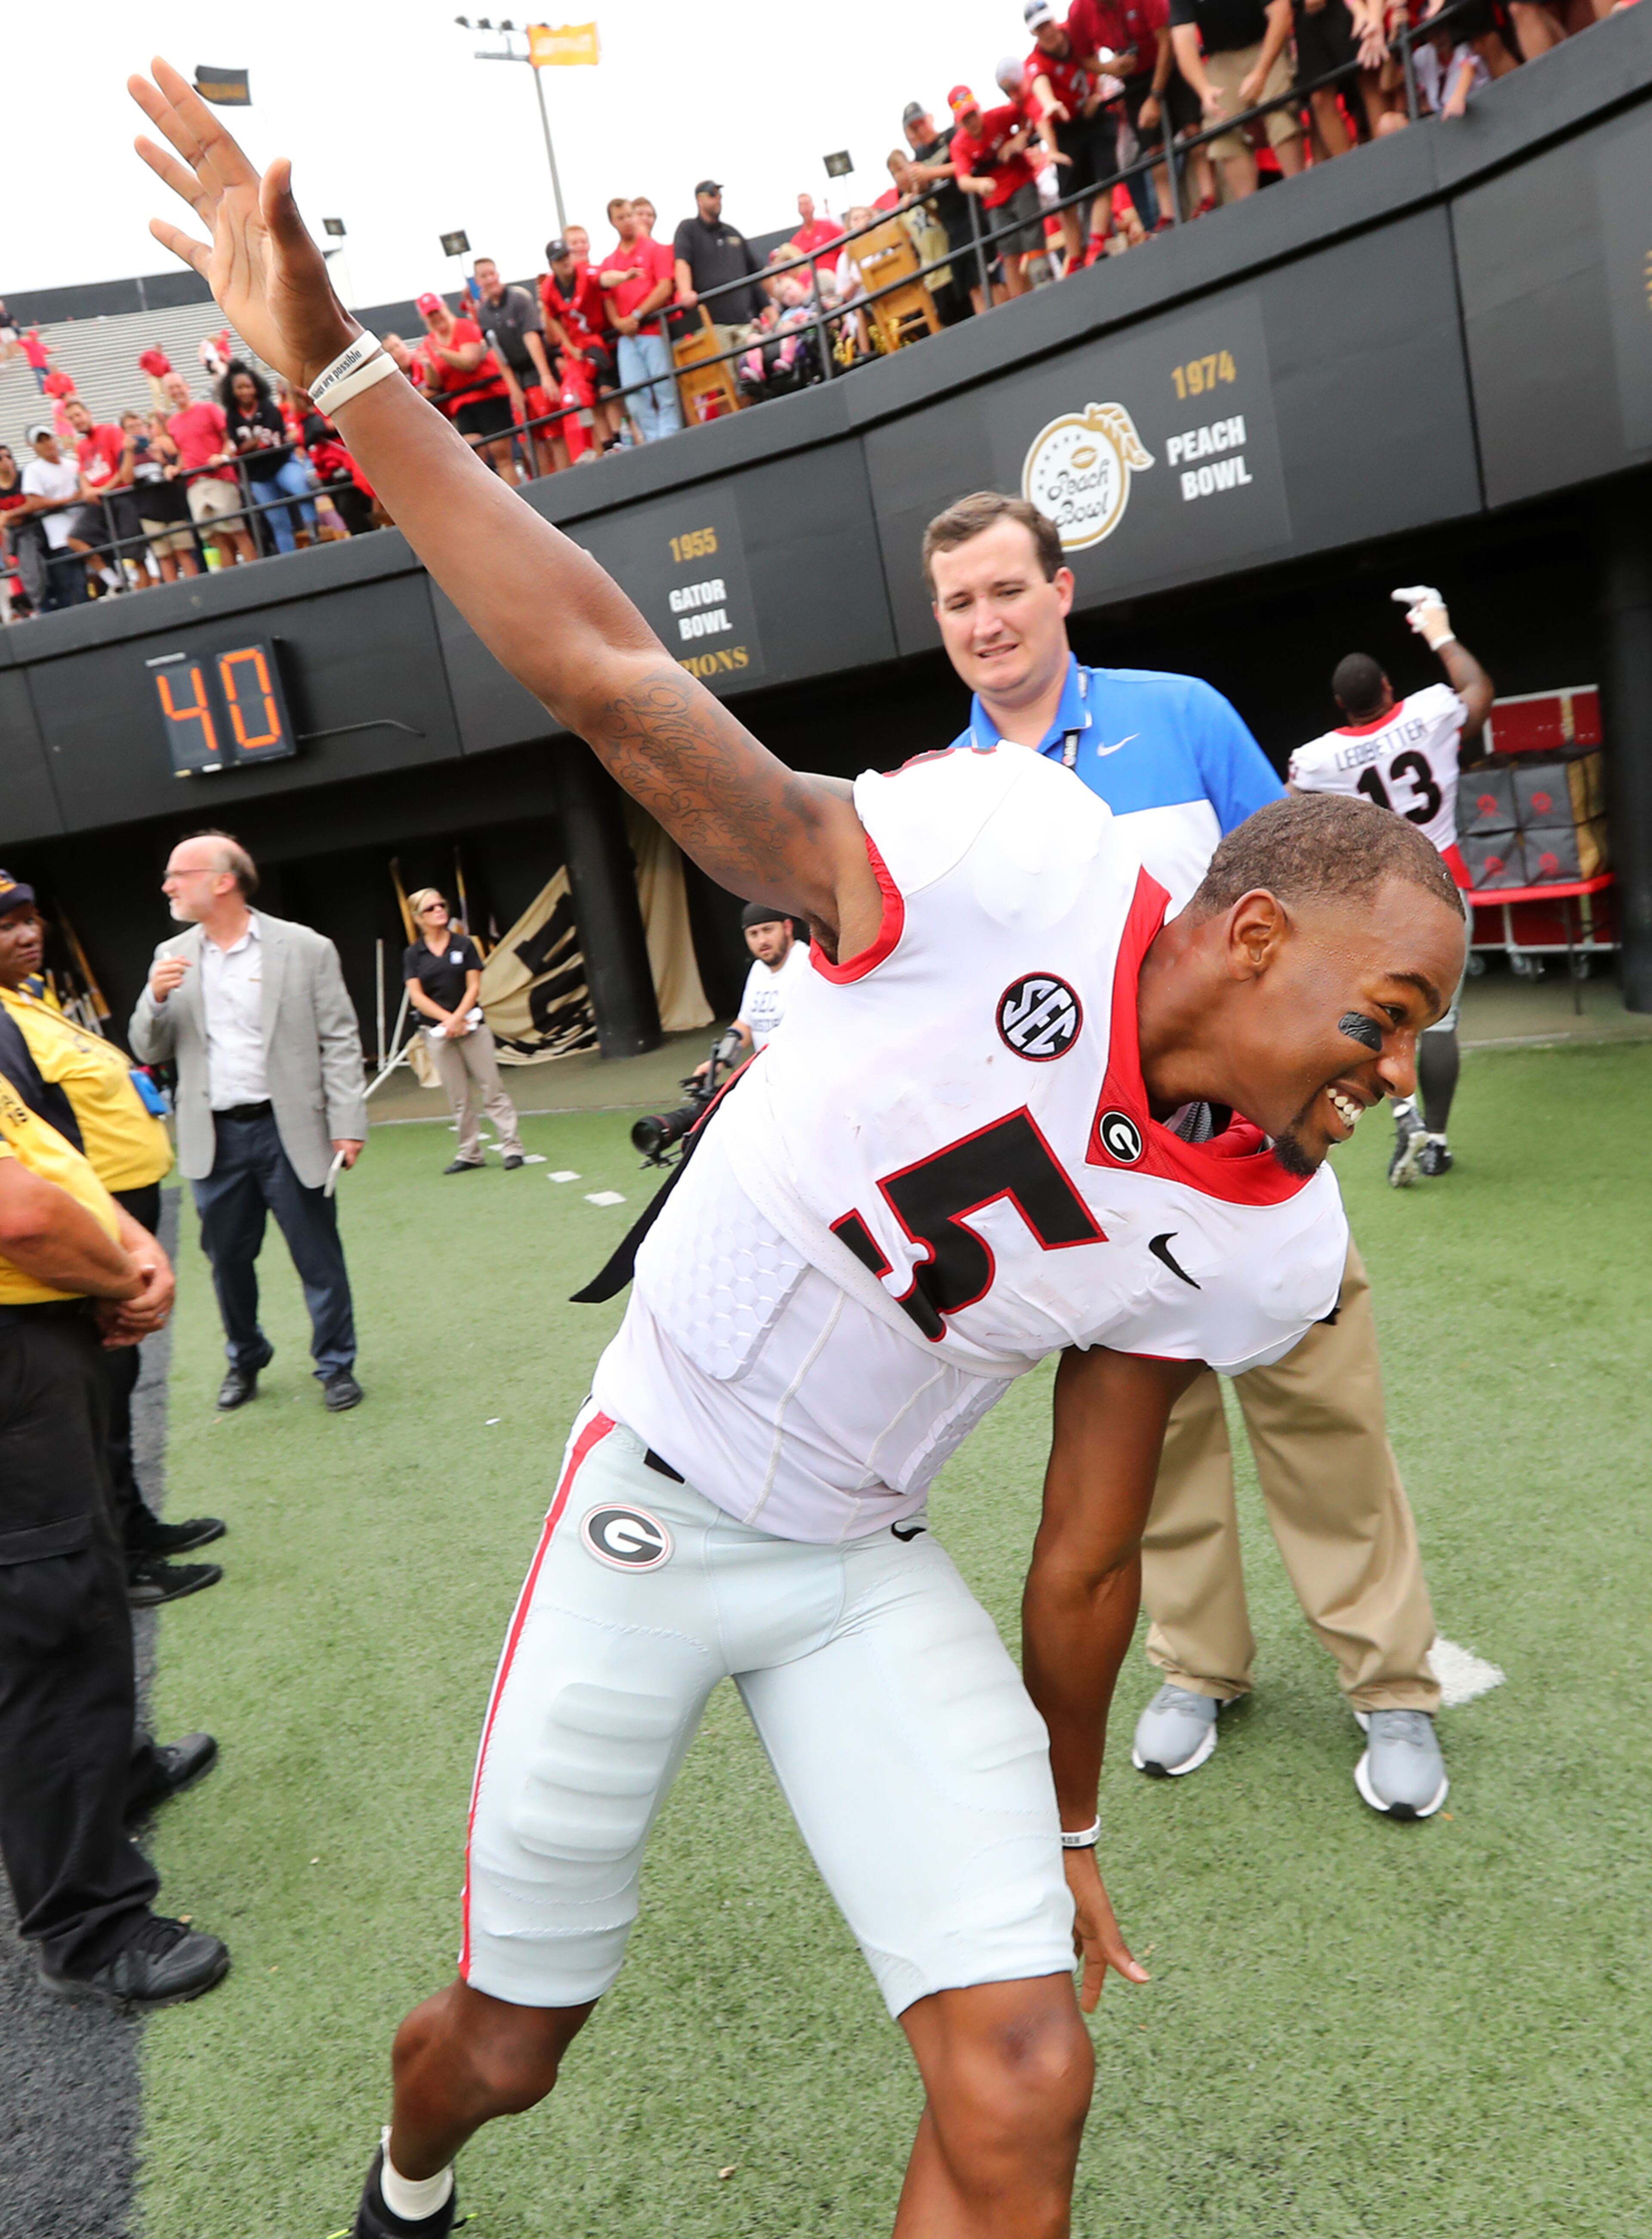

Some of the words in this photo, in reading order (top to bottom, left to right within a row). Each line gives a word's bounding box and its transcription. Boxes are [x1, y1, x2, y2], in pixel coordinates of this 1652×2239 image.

[322, 374, 335, 387] are
[332, 349, 362, 380] possible
[1171, 349, 1236, 400] 1974
[1165, 414, 1247, 467] PEACH
[1047, 459, 1110, 501] Peach
[1180, 455, 1253, 502] BOWL
[1055, 489, 1109, 528] Bowl
[669, 526, 718, 563] 1955
[669, 578, 727, 613] GATOR
[678, 608, 733, 641] BOWL
[155, 647, 282, 750] 40
[1335, 717, 1430, 772] LEDBETTER
[1357, 749, 1443, 825] 13
[1003, 979, 1076, 1054] SEC
[1100, 1112, 1141, 1161] G
[829, 1103, 1110, 1342] 5
[588, 1510, 664, 1563] G
